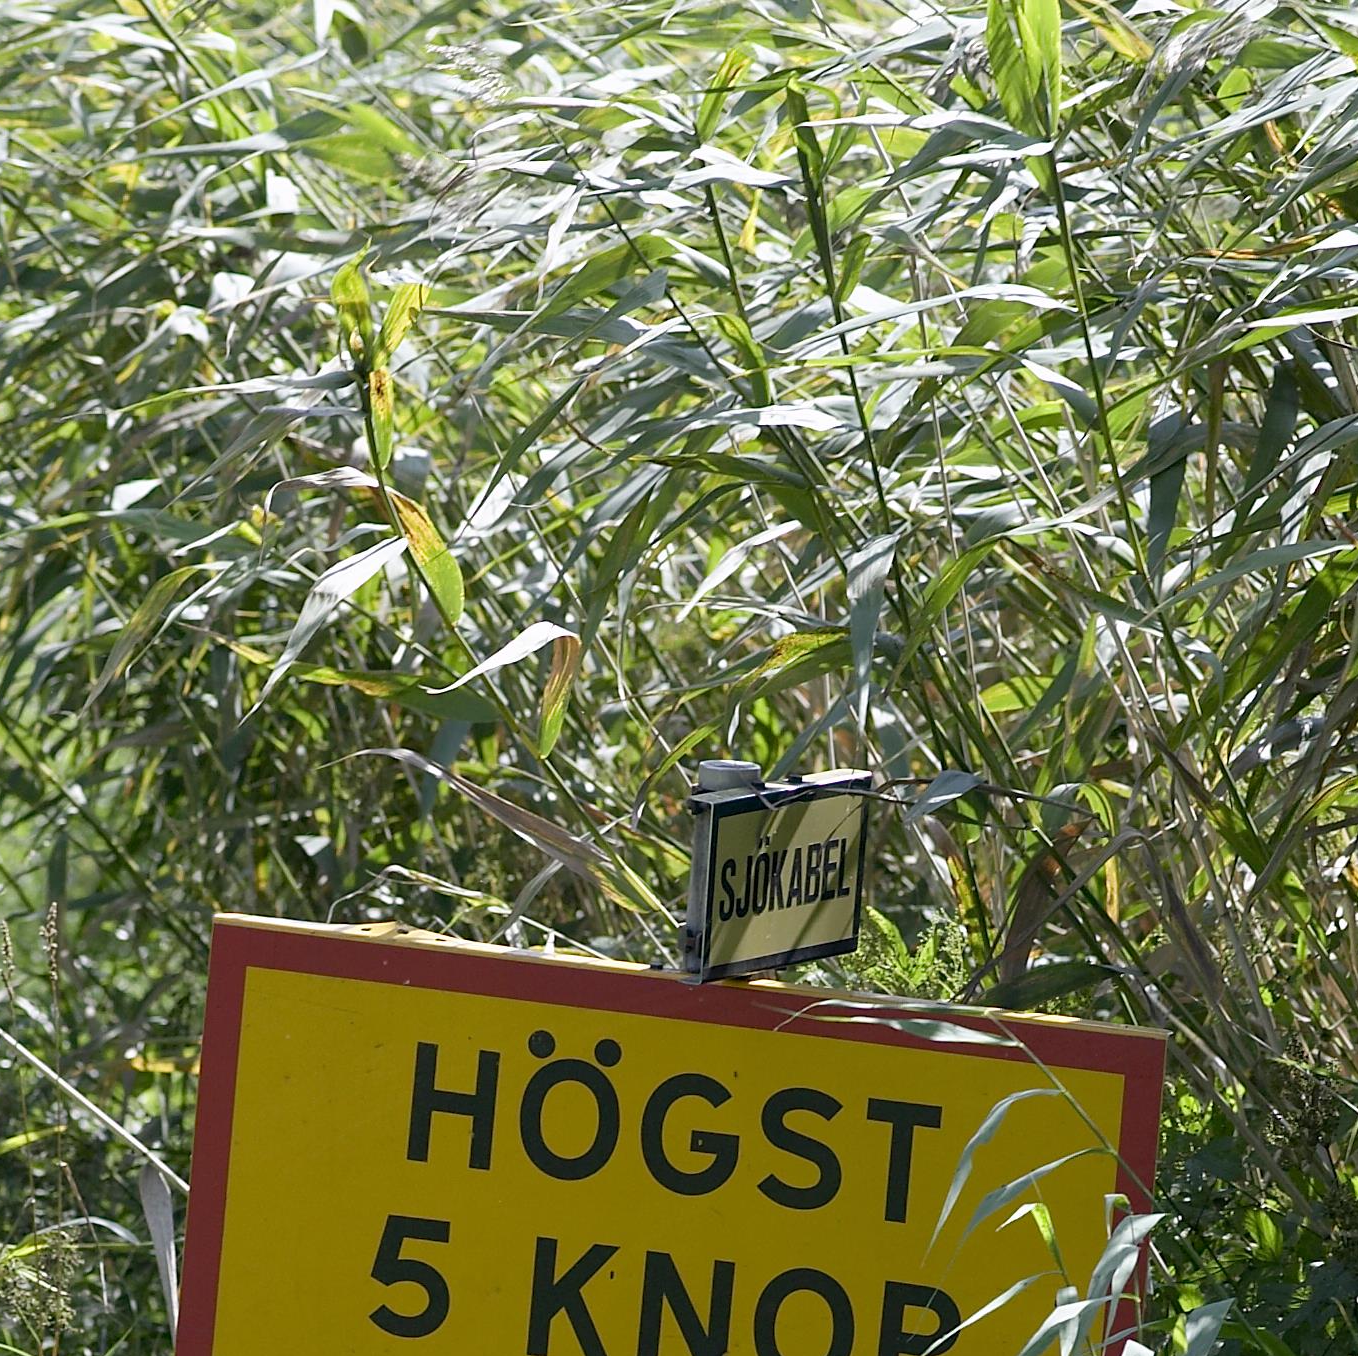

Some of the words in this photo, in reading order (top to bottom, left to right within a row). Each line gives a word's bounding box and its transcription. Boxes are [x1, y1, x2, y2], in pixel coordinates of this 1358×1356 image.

[719, 836, 850, 922] SJÖKABEL
[406, 1029, 942, 1223] HÖGST
[369, 1214, 451, 1338] 5
